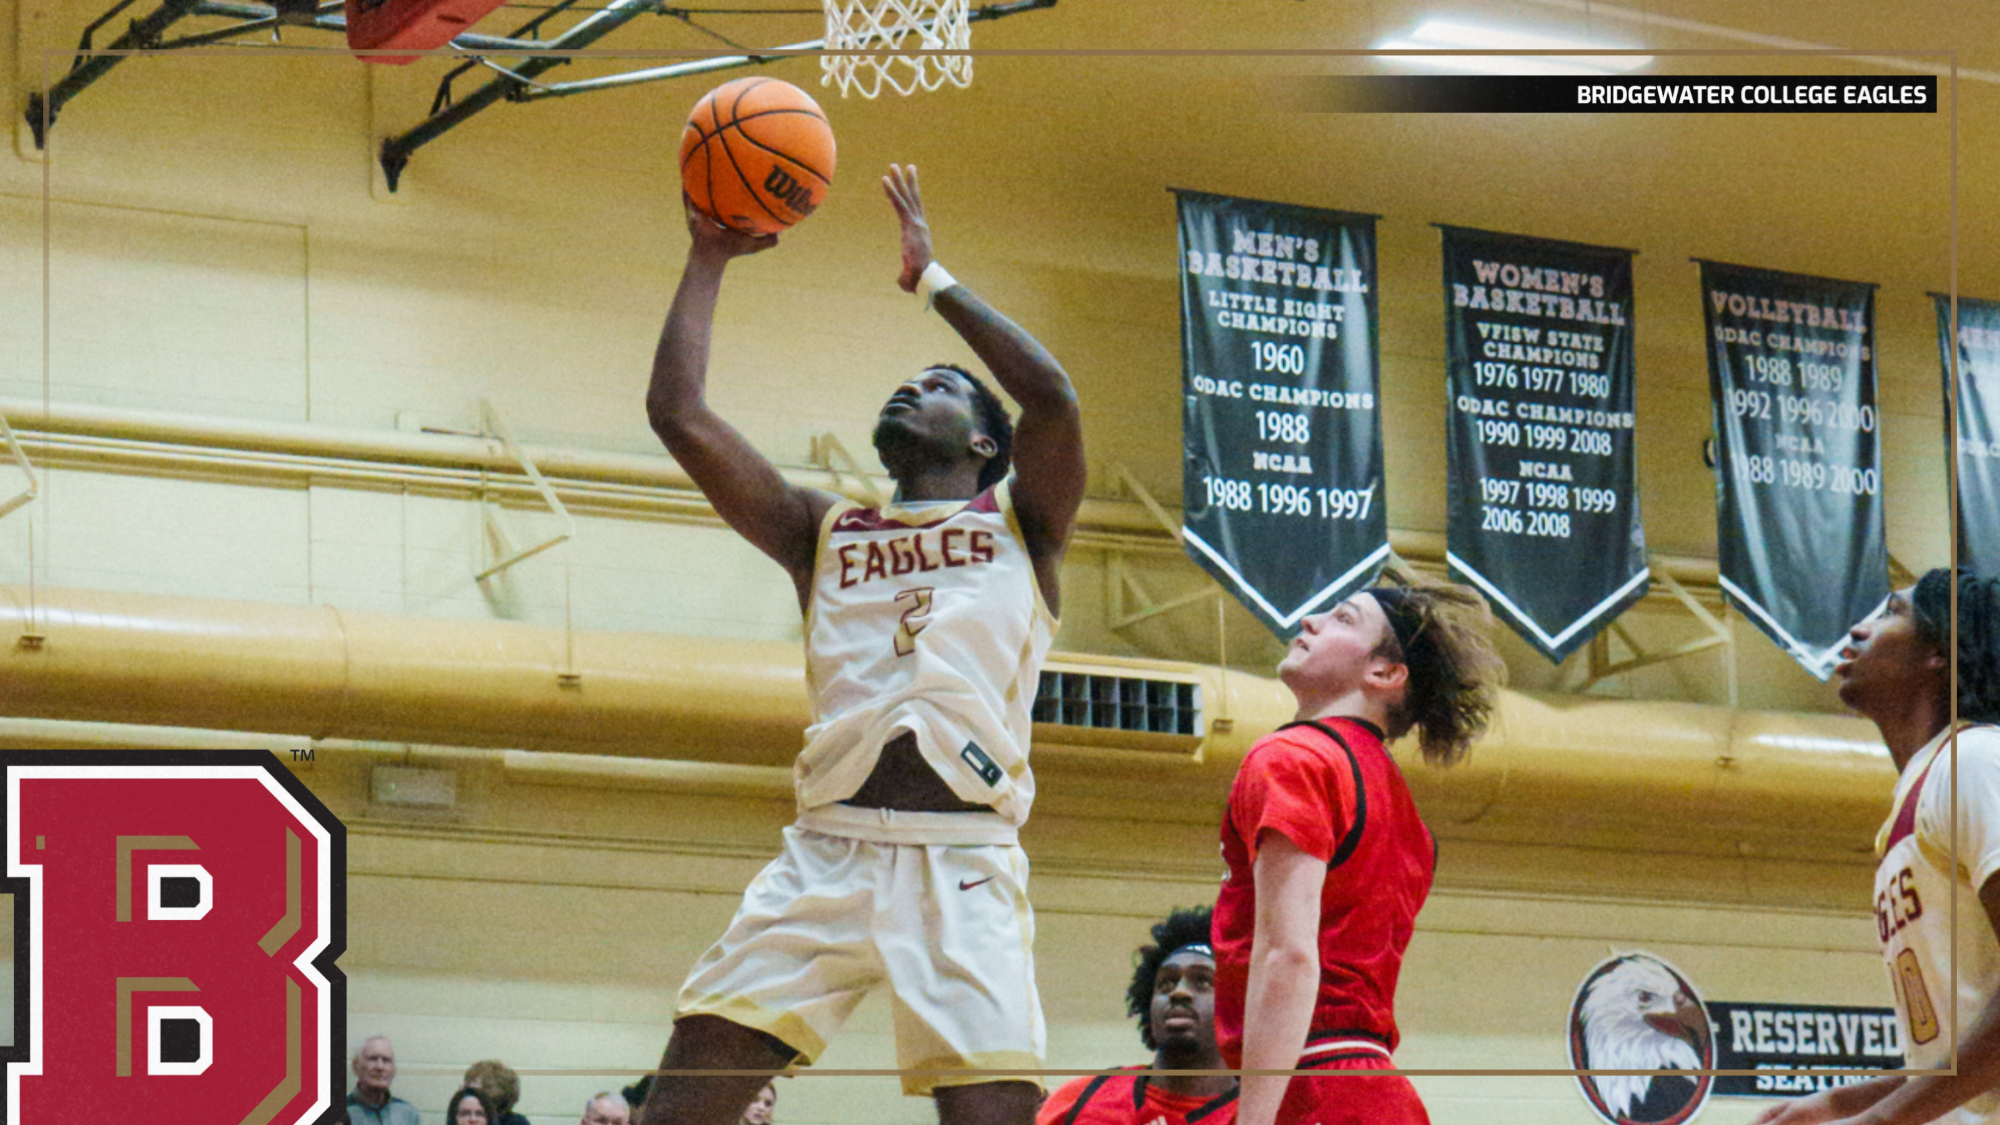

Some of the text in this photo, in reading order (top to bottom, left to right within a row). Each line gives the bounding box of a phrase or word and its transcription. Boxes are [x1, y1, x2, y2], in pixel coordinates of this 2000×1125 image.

[1233, 228, 1319, 262] MEN'S
[1188, 250, 1369, 293] BASKETBALL
[1473, 260, 1604, 297] WOMEN'S
[1209, 290, 1345, 322] LITTLE EIGHT
[1453, 283, 1624, 326] BASKETBALL
[1711, 290, 1867, 334] VOLLEYBALL
[1217, 311, 1337, 339] CHAMPIONS
[1477, 322, 1604, 352] VFISW STATE
[1715, 326, 1762, 347] ODAC
[1251, 341, 1304, 375] 1960
[1483, 341, 1599, 369] CHAMPIONS
[1745, 354, 1842, 392] 1988 1989
[1193, 375, 1374, 409] ODAC CHAMPIONS
[1473, 362, 1610, 399] 1976 1977 1980
[1255, 411, 1310, 444] 1988
[1457, 395, 1634, 428] ODAC CHAMPIONS
[1728, 388, 1874, 432] 1992 1996 2000
[1475, 419, 1613, 456] 1990 1999 2008
[1253, 451, 1312, 474] NCAA
[1519, 460, 1572, 481] NCAA
[1734, 454, 1877, 495] 88 1989 2000
[1203, 476, 1373, 520] 1988 1996 1997
[1480, 477, 1616, 513] 1997 1998 1999
[1481, 506, 1570, 538] 2006 2008
[838, 529, 995, 589] EAGLES
[894, 586, 935, 657] 2
[1729, 1010, 1903, 1057] RESERVED
